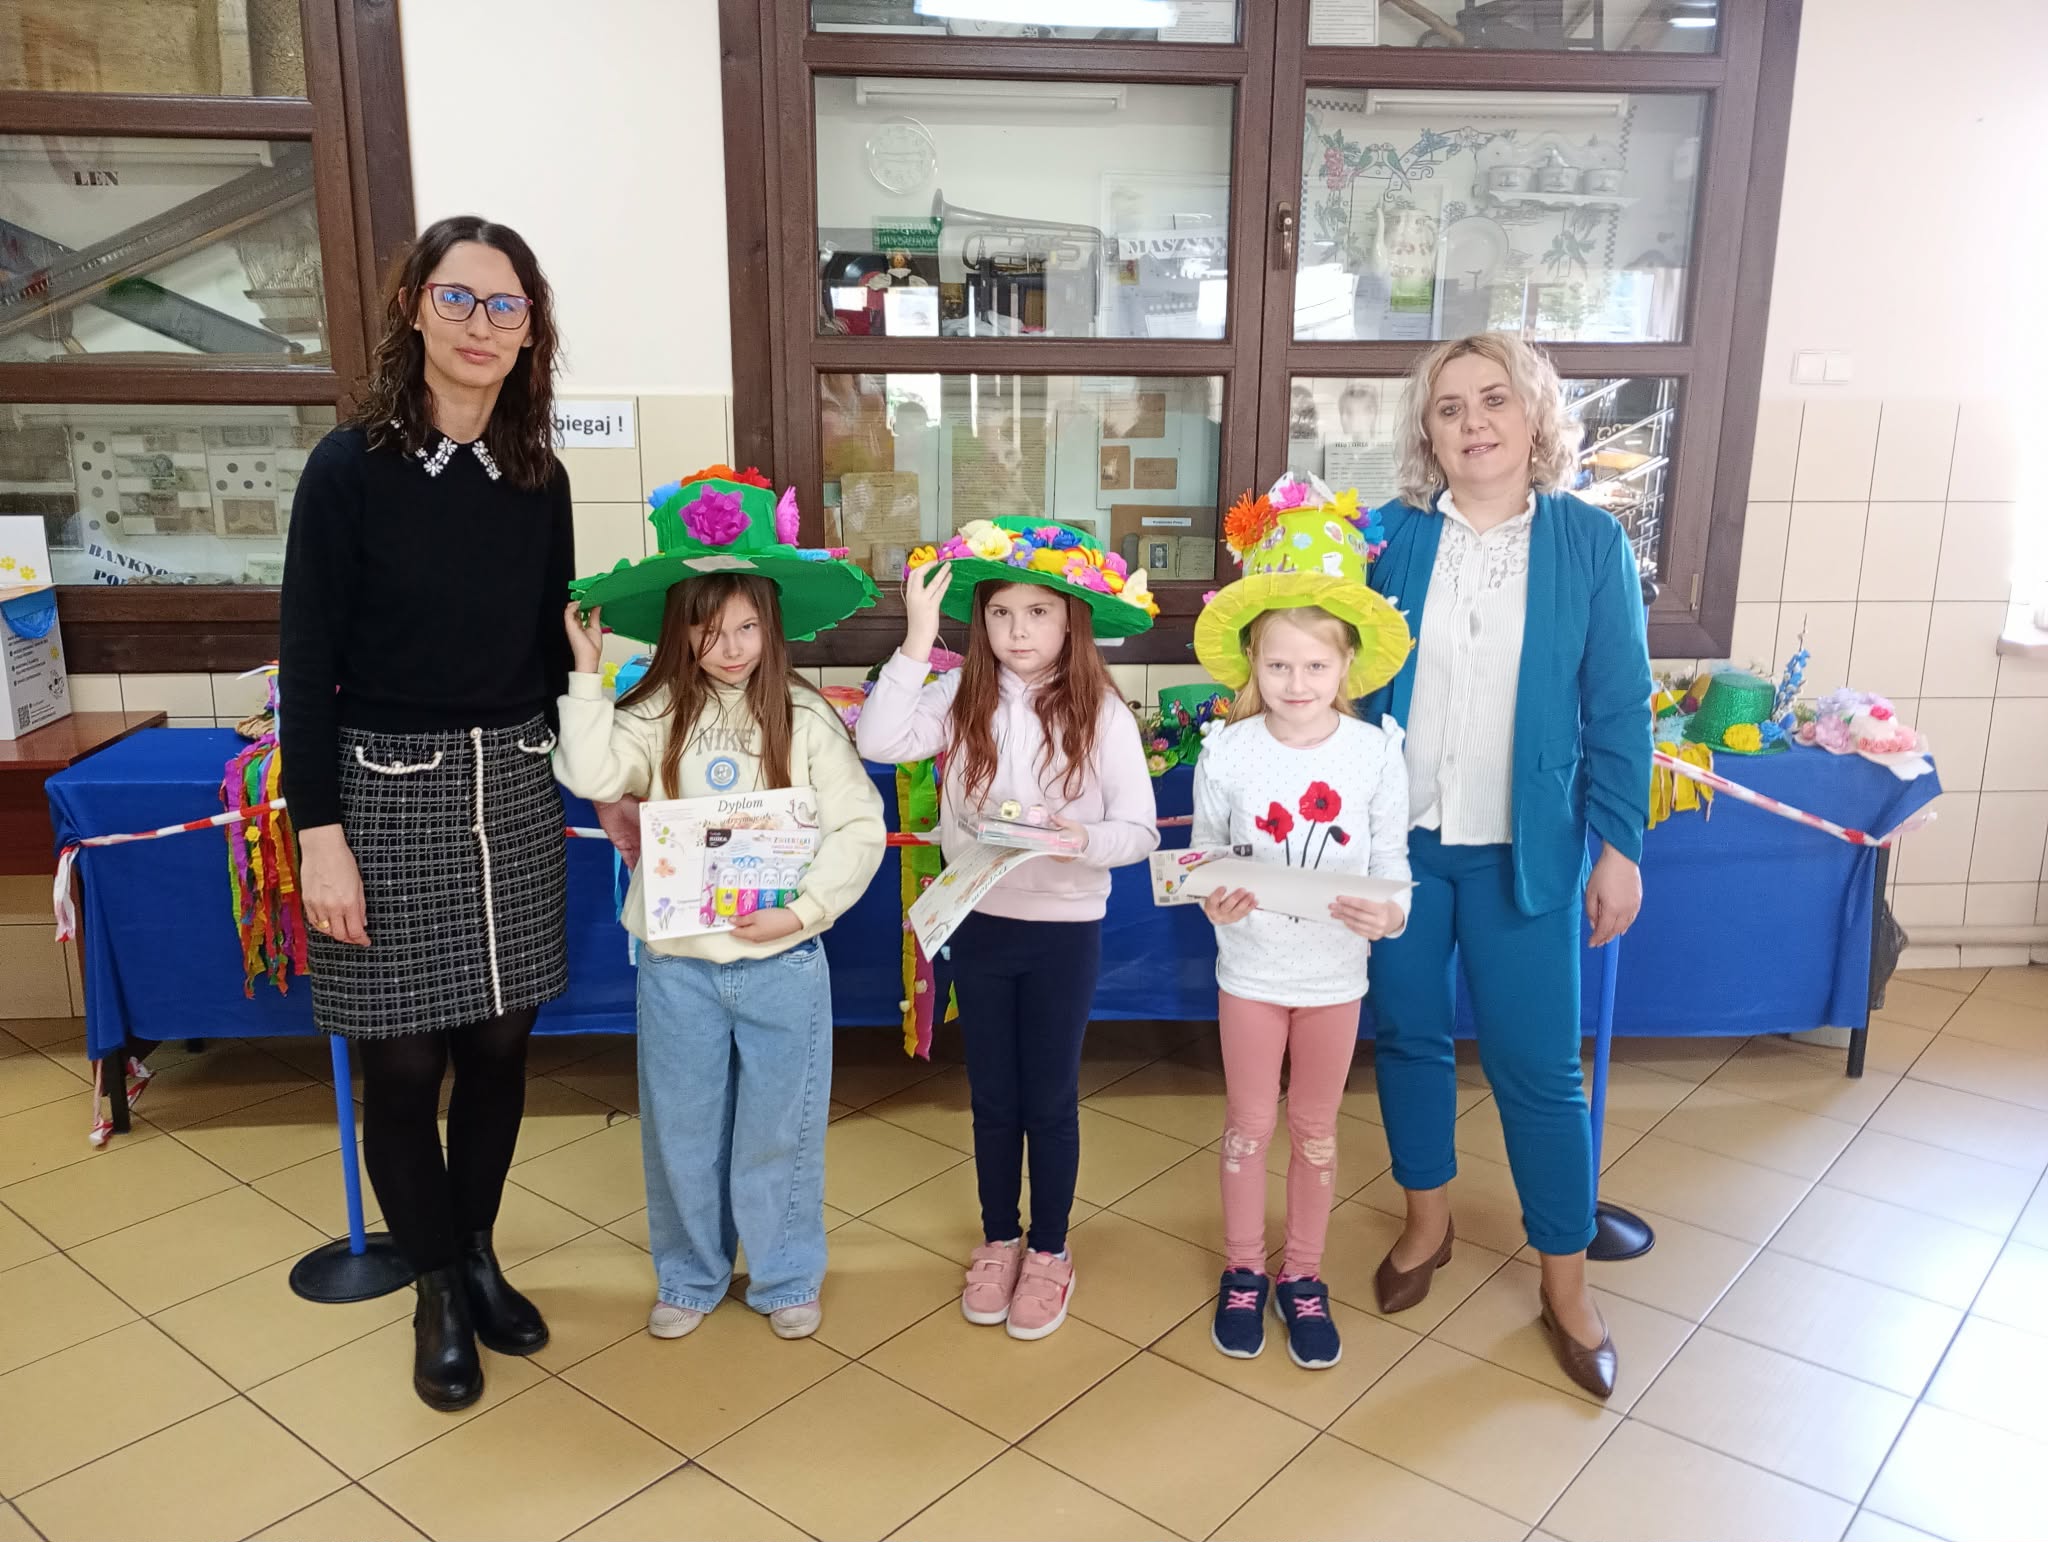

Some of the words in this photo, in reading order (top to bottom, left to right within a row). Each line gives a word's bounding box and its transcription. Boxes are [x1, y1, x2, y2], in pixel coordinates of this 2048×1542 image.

[73, 171, 119, 185] LEN
[618, 415, 623, 432] !
[88, 543, 174, 577] BANKNO
[696, 728, 756, 756] NIKE
[717, 797, 763, 814] Dyplom
